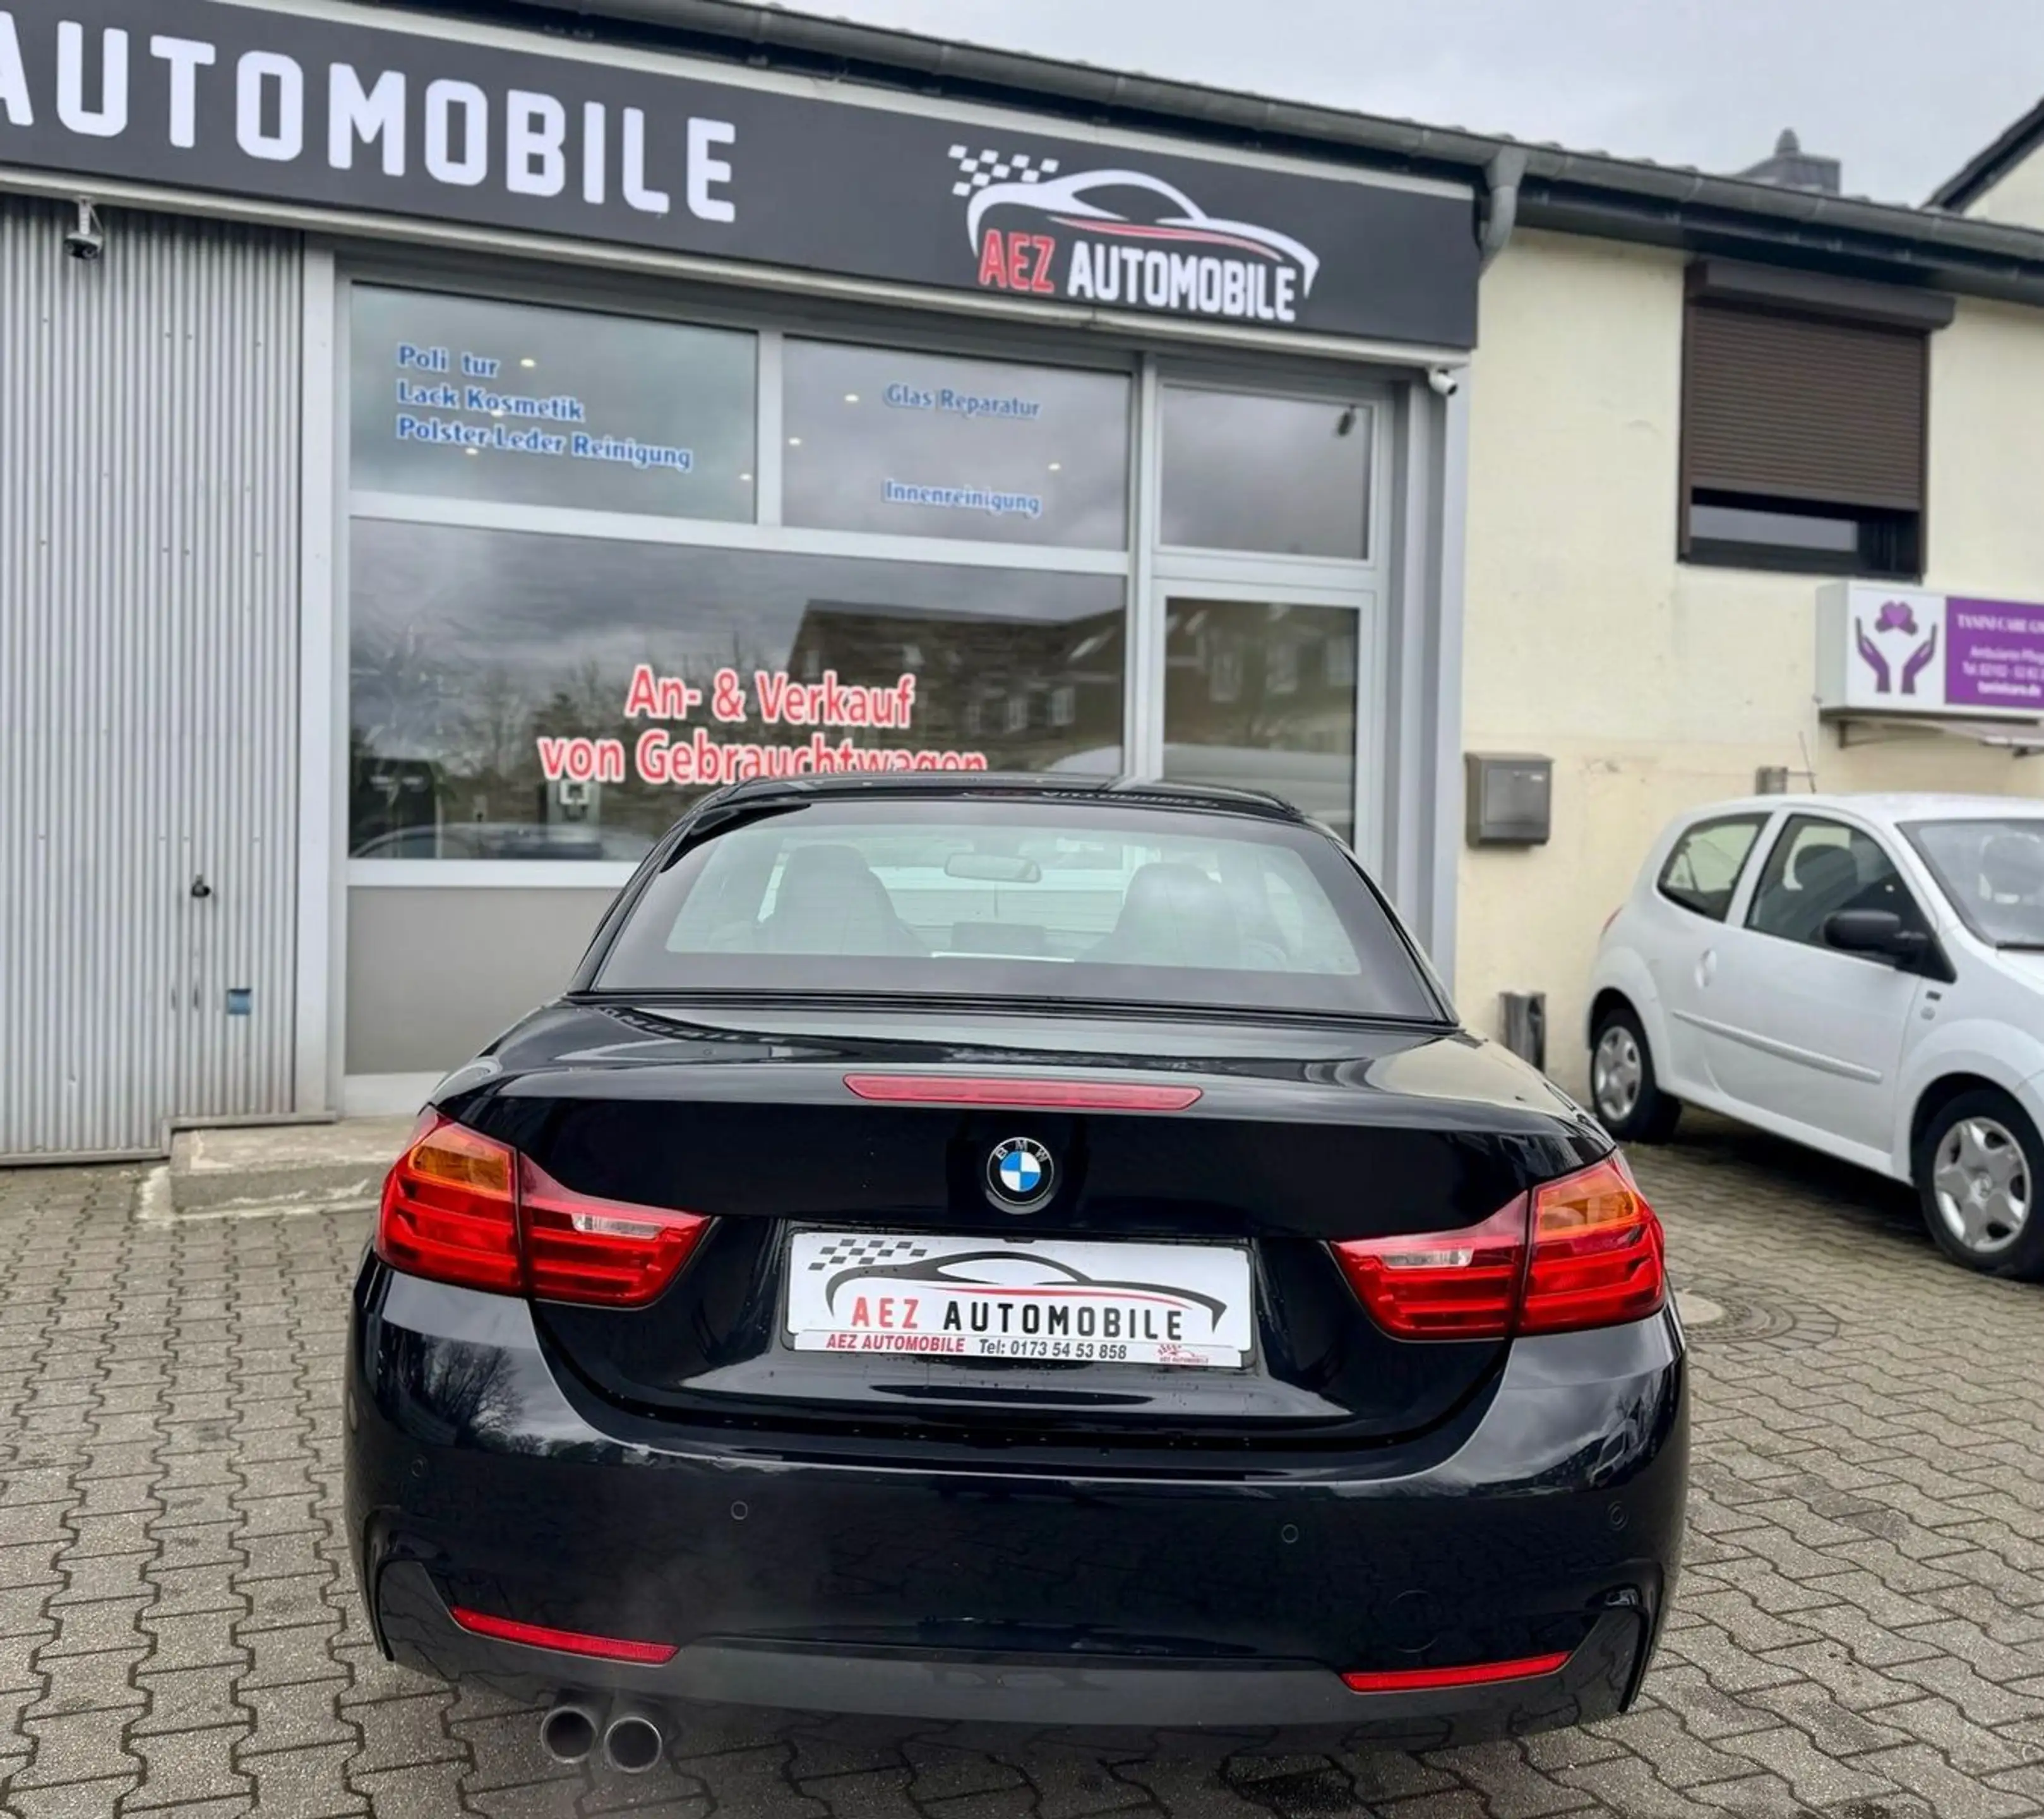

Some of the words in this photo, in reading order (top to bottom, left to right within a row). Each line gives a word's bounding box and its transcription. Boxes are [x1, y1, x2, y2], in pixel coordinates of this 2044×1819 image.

[979, 229, 1055, 294] AEZ
[1067, 241, 1296, 321] AUTOMOBILE
[398, 380, 458, 409] Lack
[465, 387, 585, 422] Kosmetik
[886, 382, 933, 407] Glas
[939, 387, 1041, 417] Reparatur
[398, 415, 489, 445] Polster
[495, 426, 565, 455] Leder
[571, 432, 693, 472] Reinigung
[885, 479, 1041, 517] Innenreinigung
[625, 664, 702, 719] An-
[712, 668, 746, 721] &
[756, 671, 915, 728] Verkauf
[537, 736, 625, 782] von
[995, 1138, 1049, 1163] BMW
[851, 1296, 919, 1329] AEZ
[943, 1301, 1181, 1341] AUTOMOBILE
[826, 1333, 856, 1349] AEZ
[861, 1335, 965, 1353] AUTOMOBILE
[979, 1338, 1005, 1355] Tel:
[1010, 1340, 1048, 1357] 0173
[1051, 1343, 1071, 1358] 54
[1075, 1344, 1094, 1359] 53
[1099, 1345, 1127, 1360] 858
